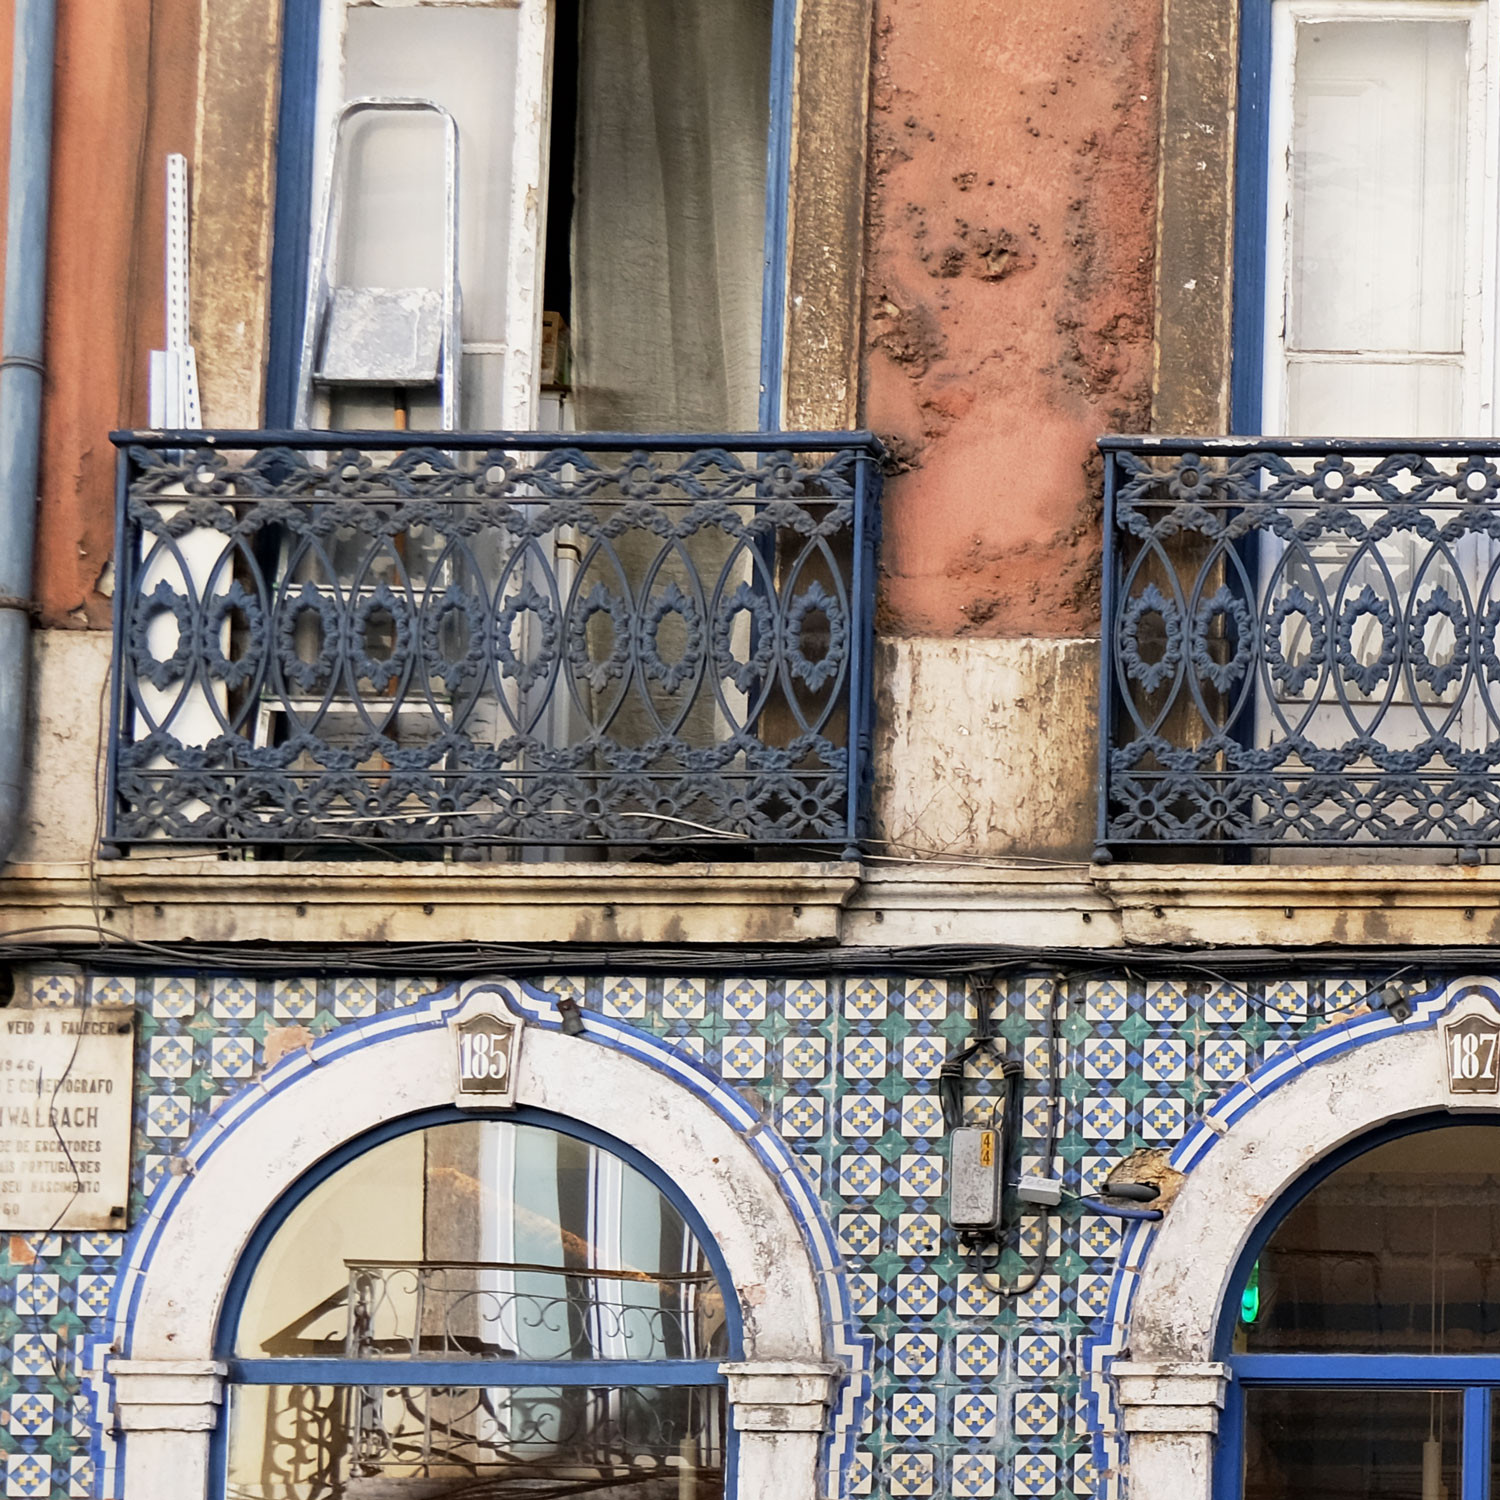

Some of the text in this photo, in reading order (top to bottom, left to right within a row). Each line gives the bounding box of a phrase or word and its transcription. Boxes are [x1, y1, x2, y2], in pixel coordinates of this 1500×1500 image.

[7, 1021, 116, 1035] VEIO A FALECER
[460, 1032, 507, 1079] 185
[1449, 1032, 1498, 1079] 187
[7, 1078, 15, 1093] E
[34, 1140, 102, 1153] ESCRITORES
[19, 1161, 102, 1173] PORTUGUESES
[30, 1181, 101, 1193] NASCIMENTO
